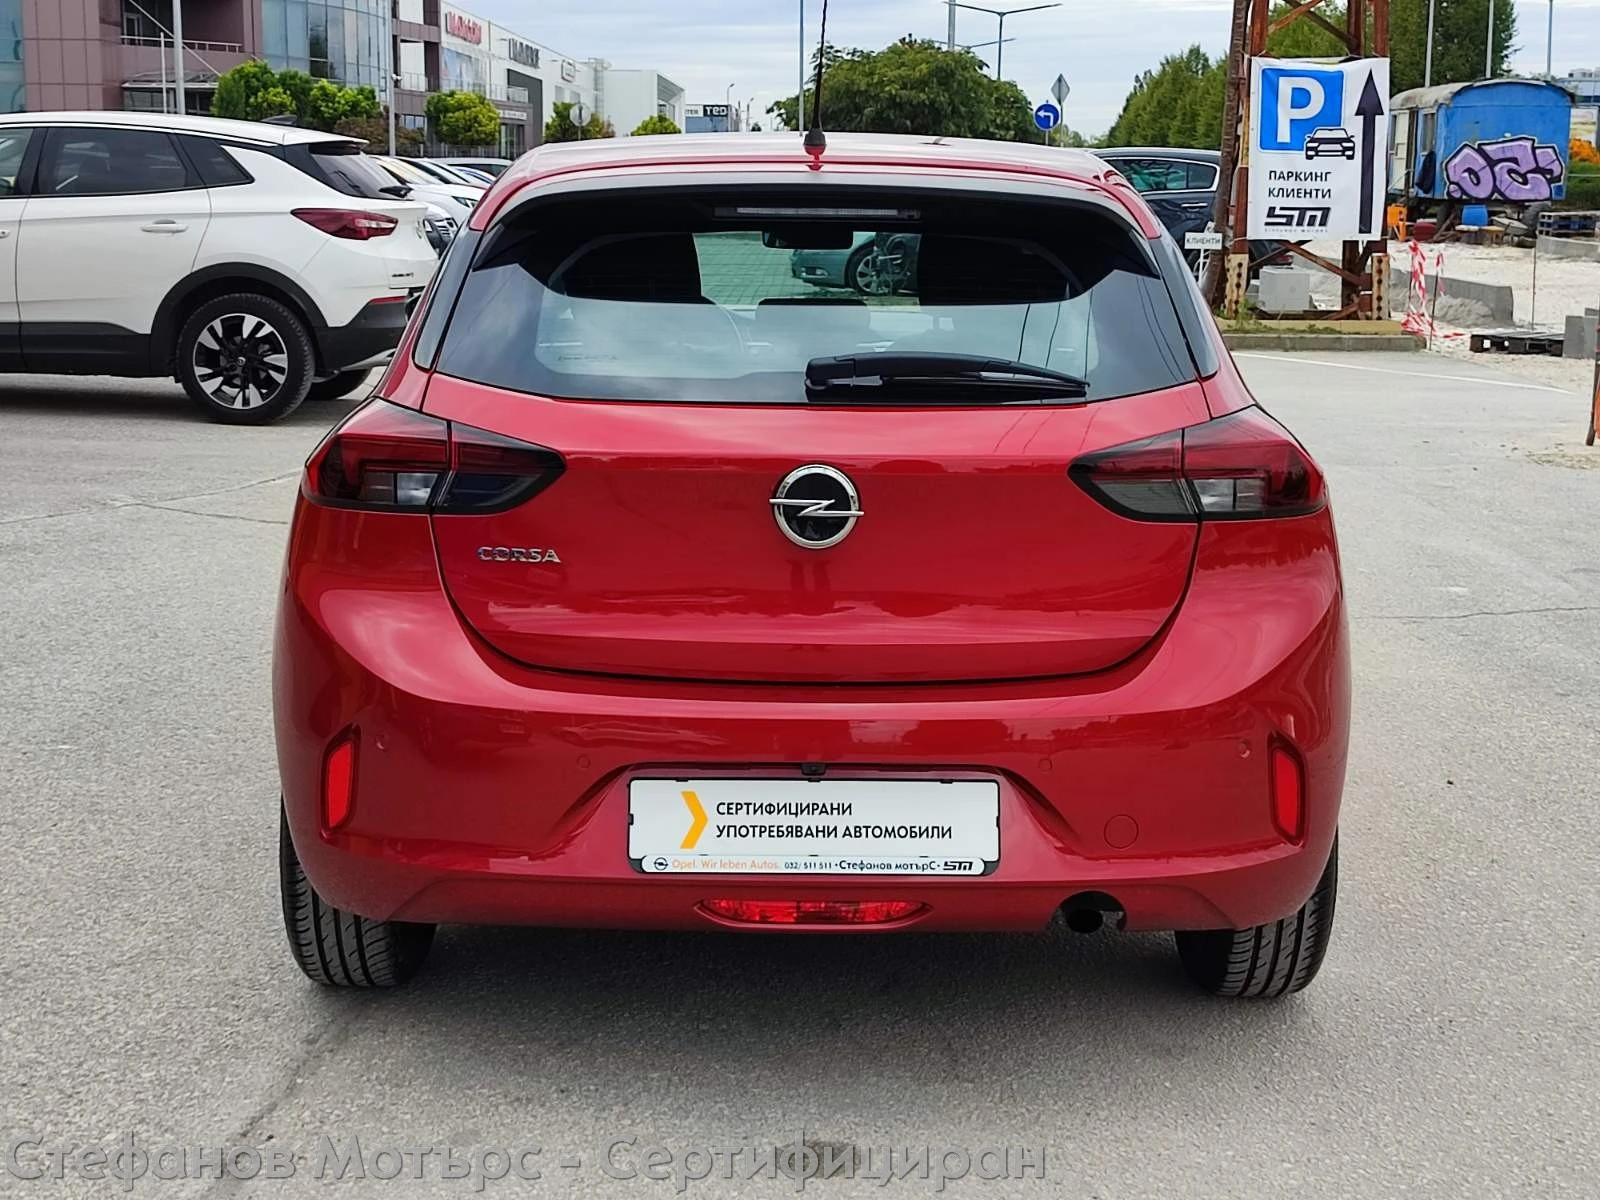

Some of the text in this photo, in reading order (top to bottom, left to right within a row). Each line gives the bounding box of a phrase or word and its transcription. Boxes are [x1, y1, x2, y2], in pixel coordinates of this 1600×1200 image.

[1276, 76, 1325, 144] P
[1268, 170, 1332, 182] ПАРКИНГ
[1268, 187, 1331, 199] КЛИЕНТИ
[477, 546, 561, 563] CORSA
[716, 801, 852, 818] СЕРТИФИЦИРАНИ
[716, 824, 953, 840] УПОТРЕБЯВАНИ АВТОМОБИЛИ
